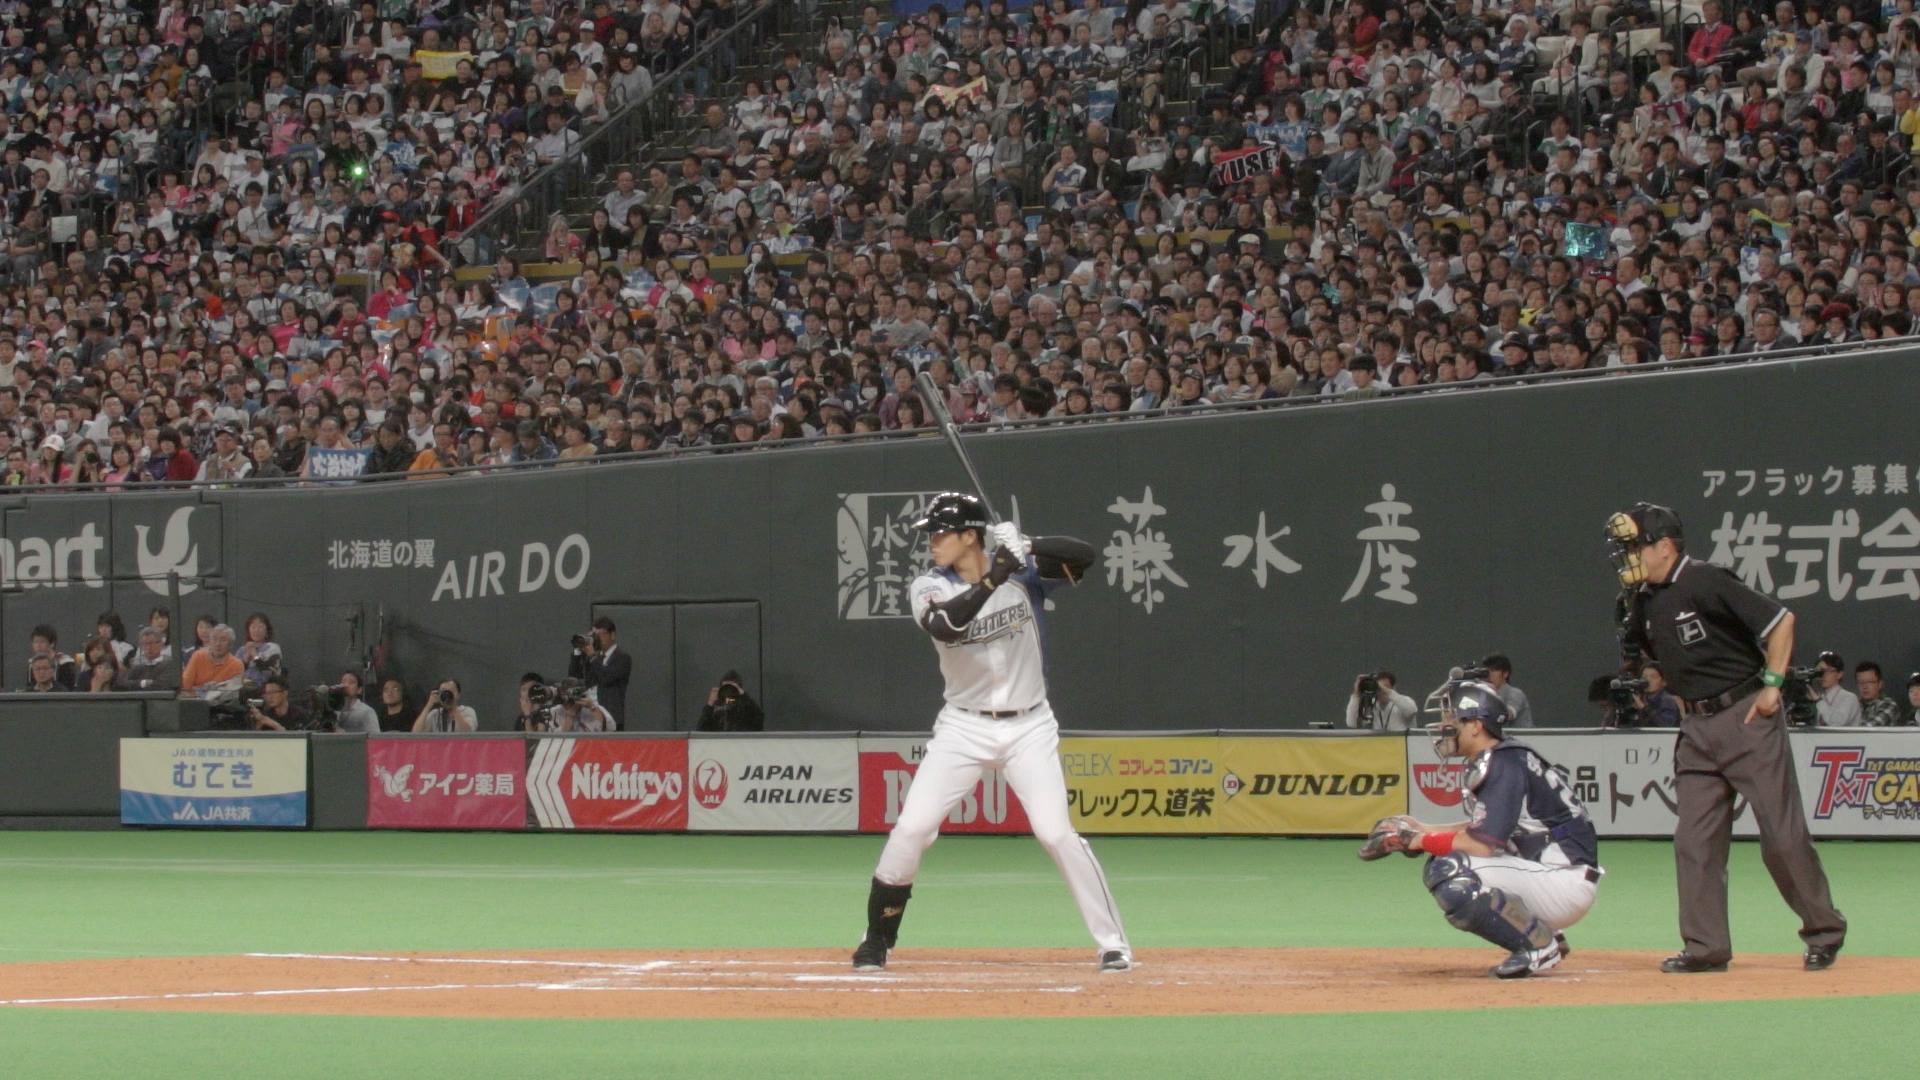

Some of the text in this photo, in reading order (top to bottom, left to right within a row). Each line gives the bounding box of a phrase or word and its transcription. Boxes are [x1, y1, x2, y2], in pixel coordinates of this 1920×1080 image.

[1702, 463, 1920, 498] アフラック募集
[328, 538, 436, 569] 北海道の翼
[431, 533, 591, 602] AIR DO
[1625, 747, 1675, 765] ログ
[172, 761, 253, 789] むてき
[419, 773, 514, 796] アイン薬局
[571, 762, 682, 806] Nichiryo
[739, 765, 813, 781] JAPAN
[1249, 774, 1400, 796] DUNLOP
[744, 788, 853, 804] AIRLINES
